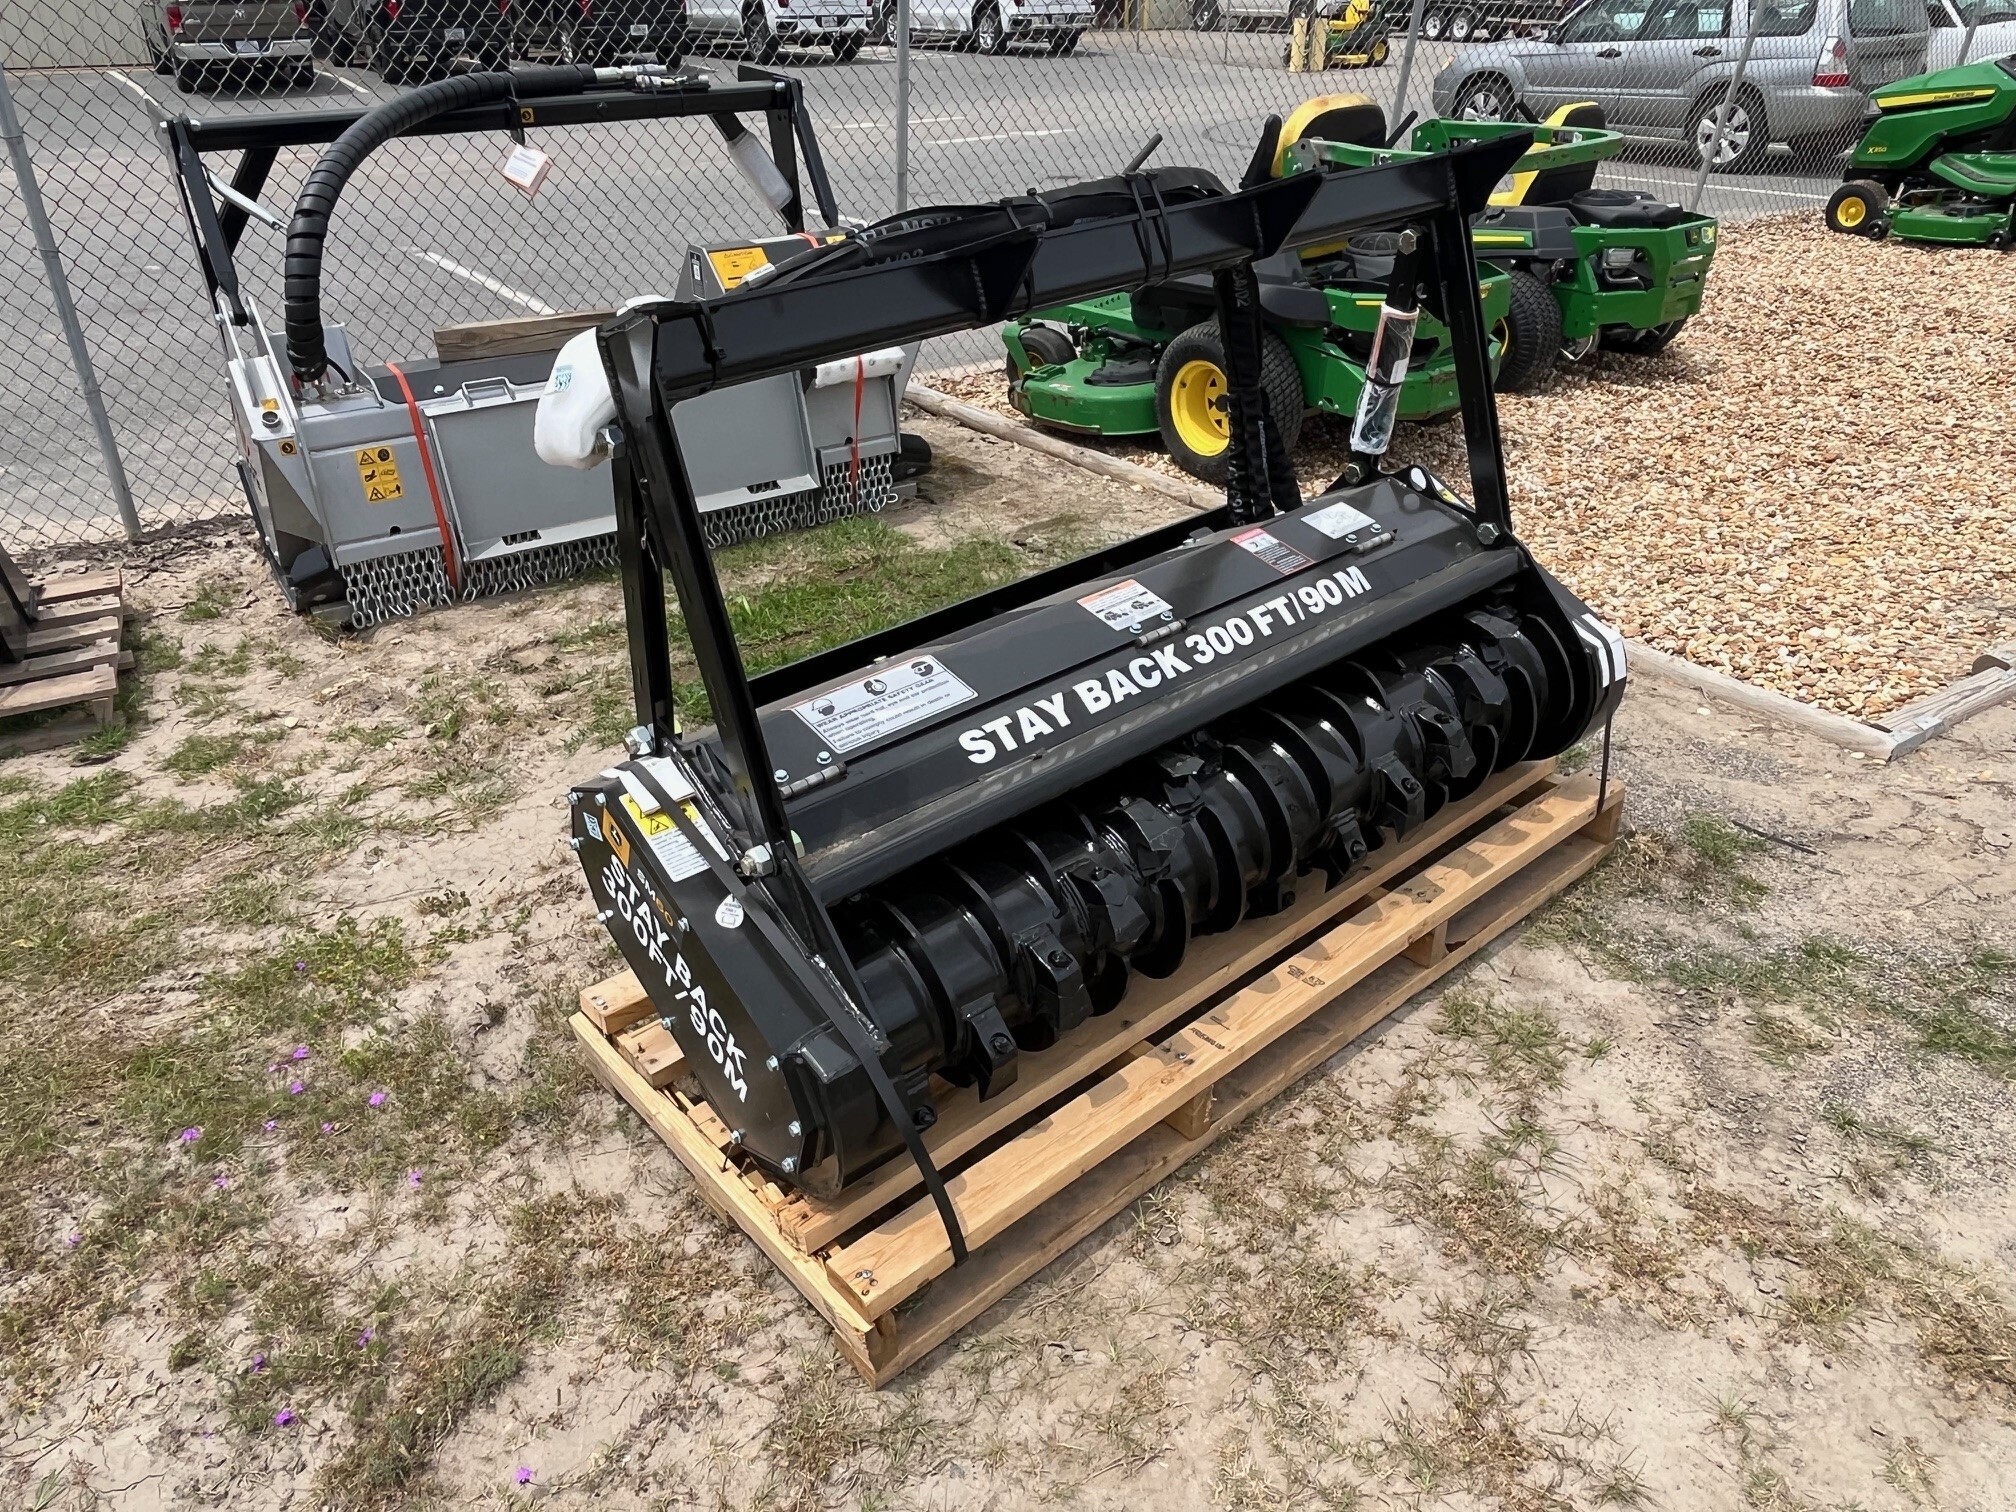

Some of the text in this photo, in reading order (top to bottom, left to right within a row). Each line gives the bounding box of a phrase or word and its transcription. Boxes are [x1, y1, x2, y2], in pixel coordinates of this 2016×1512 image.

[958, 692, 1071, 764] STAY
[1072, 643, 1192, 715] BACK
[1186, 617, 1255, 665] 300
[611, 854, 670, 949] STAY
[675, 953, 748, 1076] BACK
